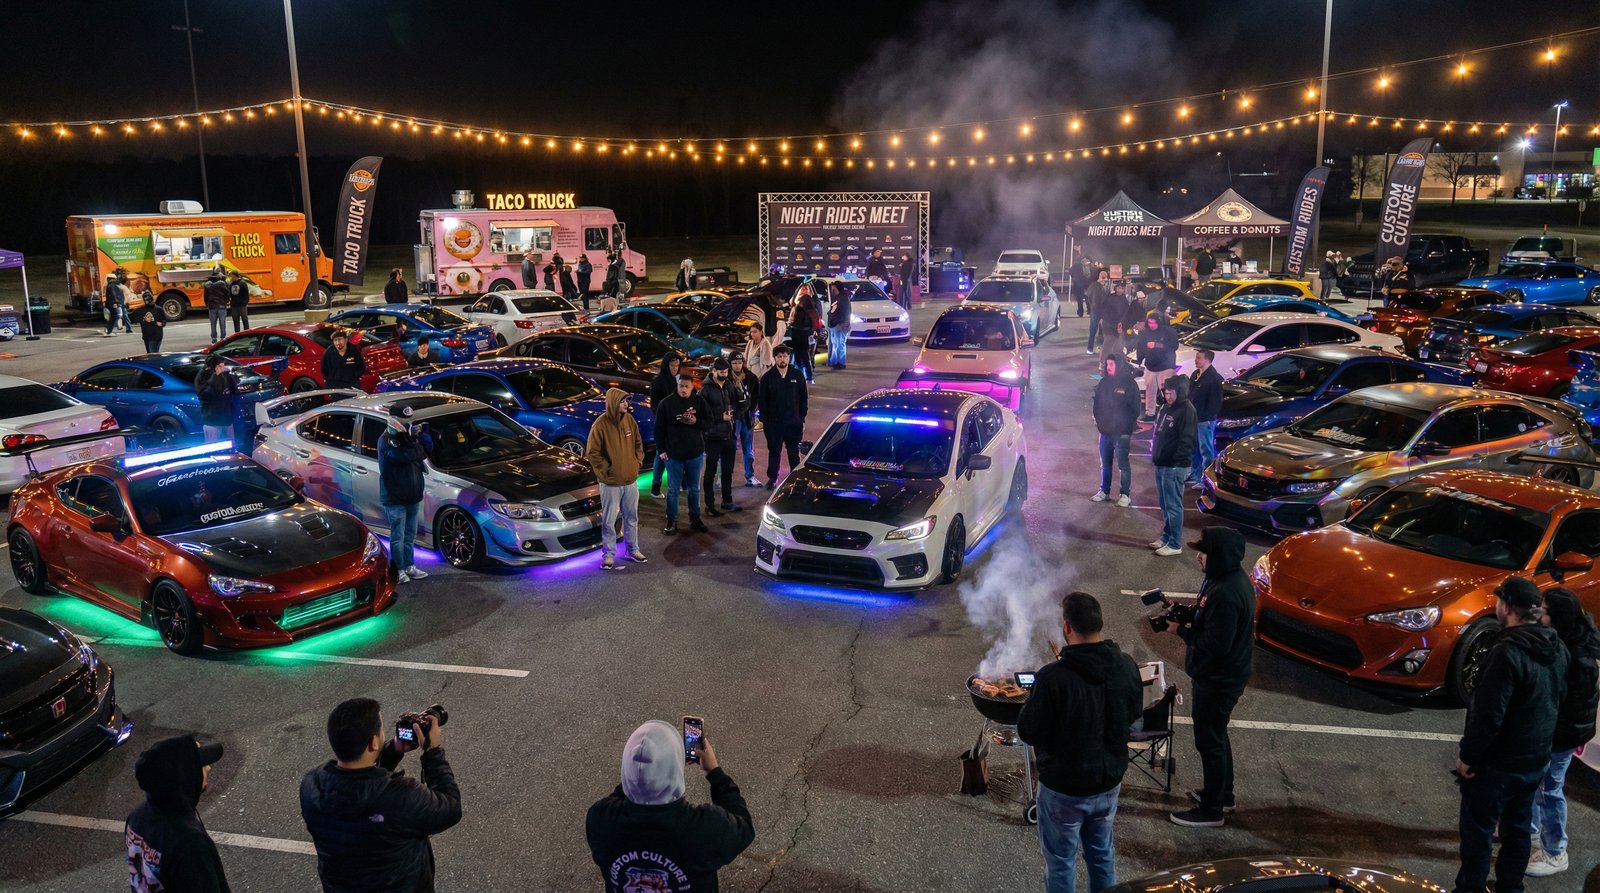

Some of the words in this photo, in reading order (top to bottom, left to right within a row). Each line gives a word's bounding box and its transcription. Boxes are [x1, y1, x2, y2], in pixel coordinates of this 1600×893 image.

[486, 193, 524, 210] TACO
[528, 193, 576, 209] TRUCK
[346, 196, 367, 239] TRUCK
[780, 207, 824, 225] NIGHT
[825, 206, 867, 224] RIDES
[869, 206, 909, 224] MEET
[1381, 182, 1404, 243] CUSTOM
[1393, 184, 1416, 246] CULTURE
[233, 232, 260, 246] TACO
[1088, 225, 1114, 236] NIGHT
[1114, 225, 1139, 236] RIDES
[1139, 225, 1163, 236] MEET
[1194, 226, 1230, 234] COFFEE
[1232, 226, 1239, 234] &
[1241, 225, 1281, 234] DONUTS
[230, 245, 266, 258] TRUCK
[342, 242, 361, 274] TACO
[641, 850, 688, 884] CULTURE
